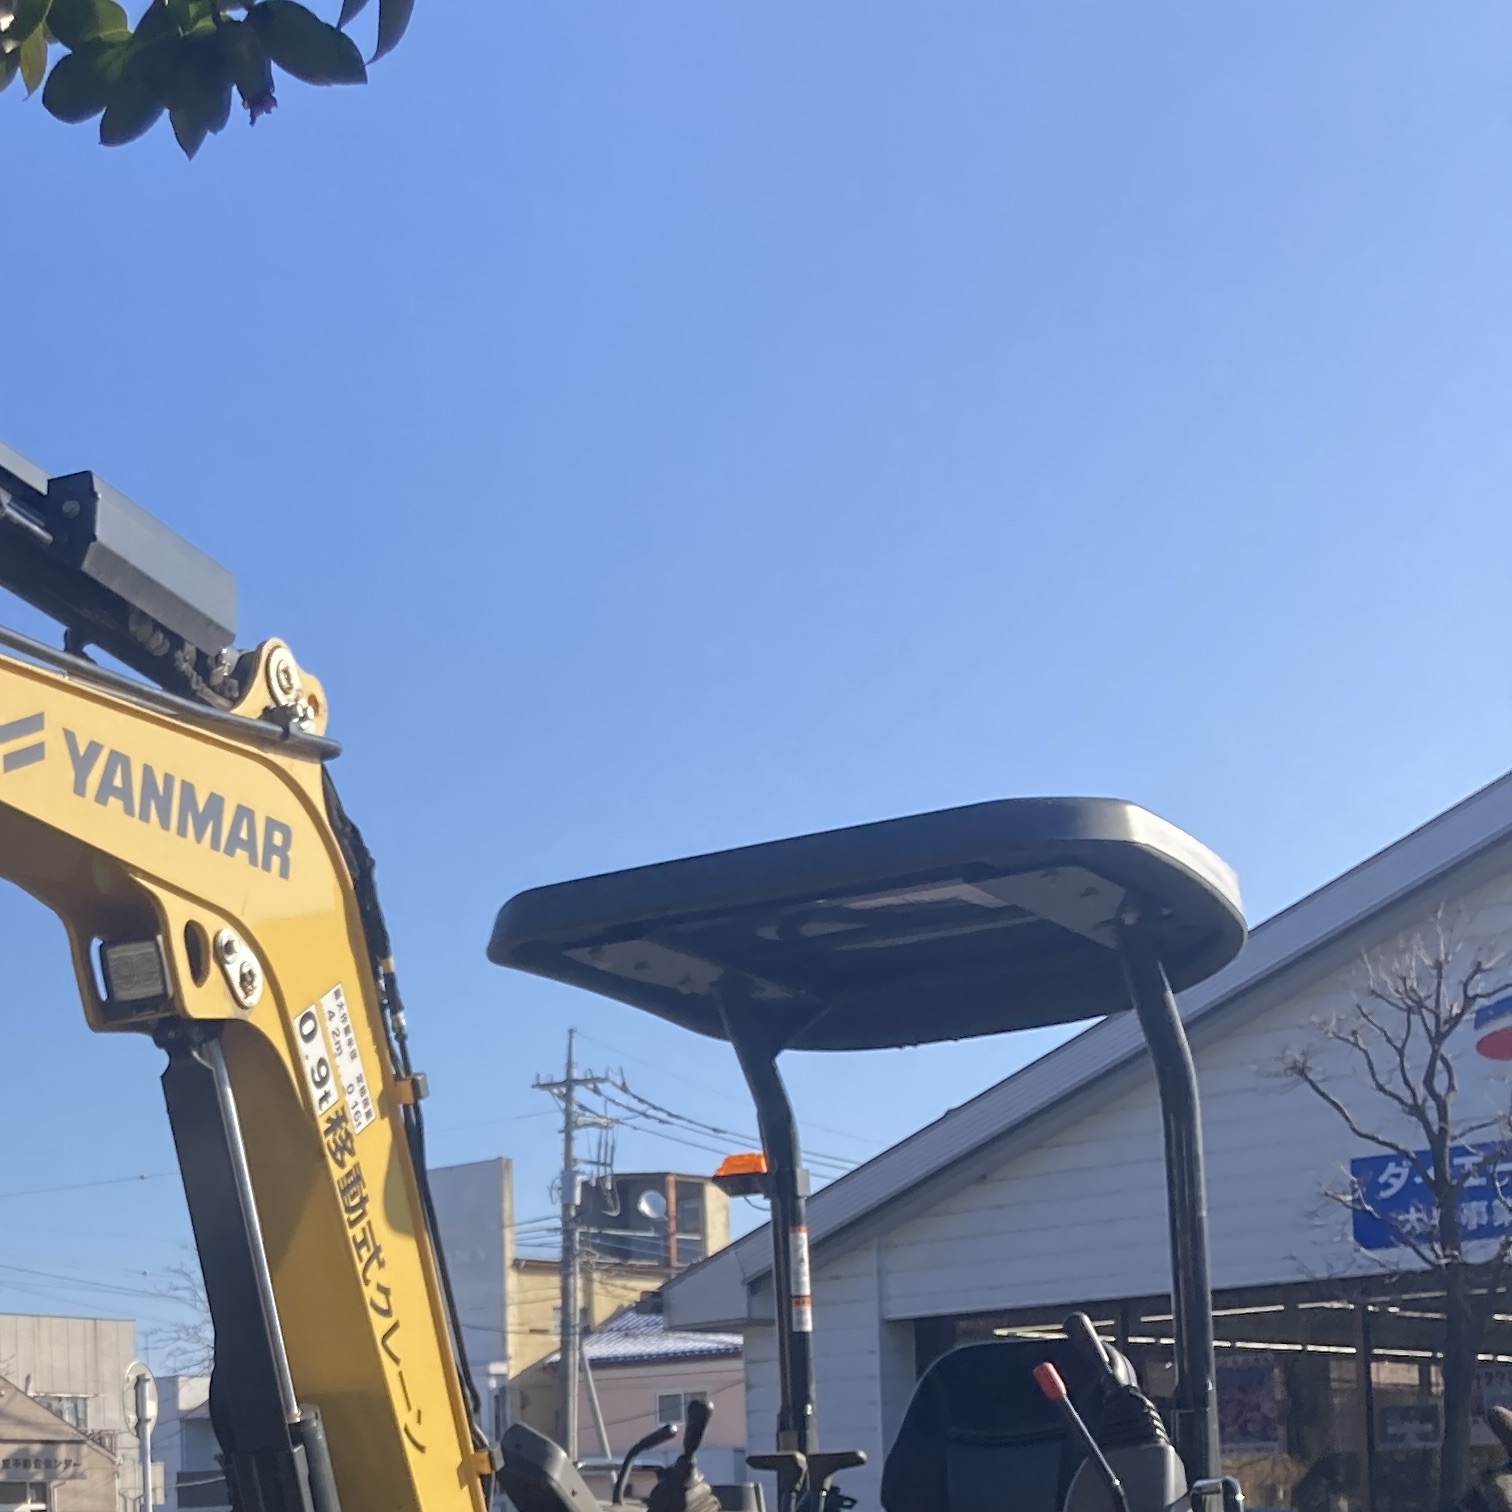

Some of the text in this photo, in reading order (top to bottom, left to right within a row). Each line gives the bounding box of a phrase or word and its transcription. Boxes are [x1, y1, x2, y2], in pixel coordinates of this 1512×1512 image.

[62, 728, 292, 880] YANMAR
[299, 1010, 331, 1111] 0.9t
[322, 1106, 426, 1454] 移動式クレーン
